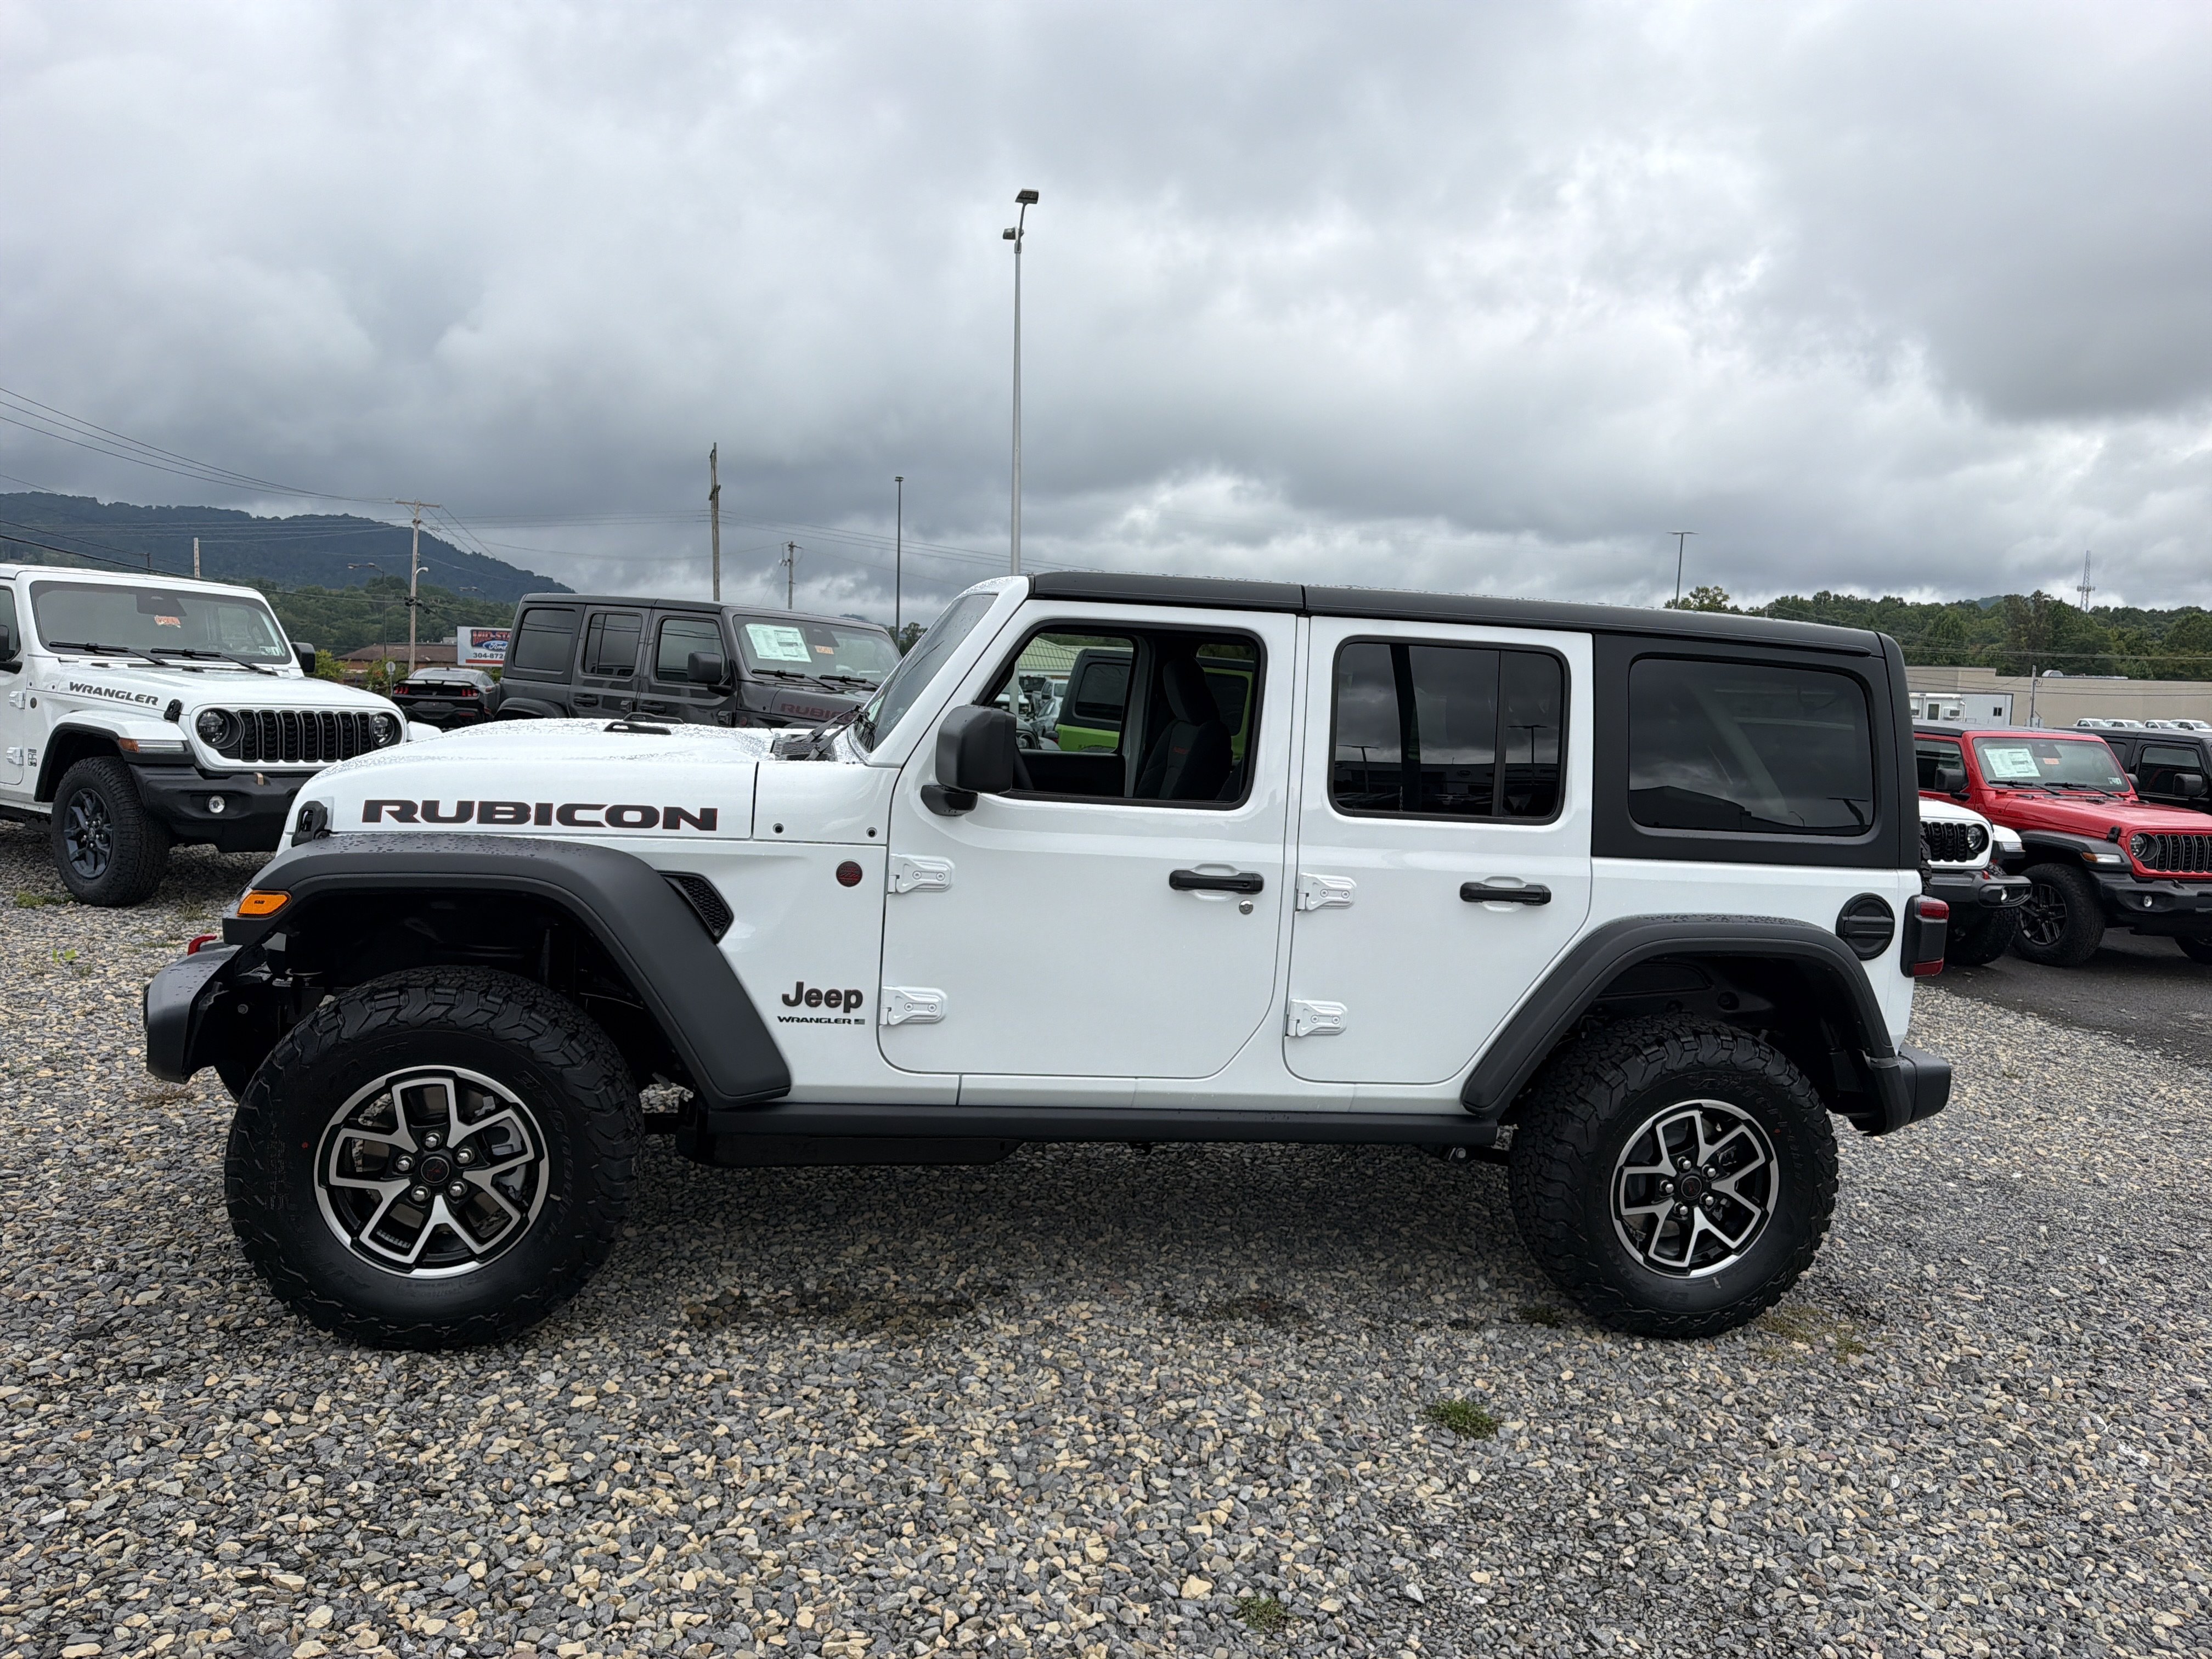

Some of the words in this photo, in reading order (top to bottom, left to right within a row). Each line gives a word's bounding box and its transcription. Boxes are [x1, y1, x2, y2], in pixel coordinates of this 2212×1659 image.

[472, 631, 511, 646] MID-STA
[488, 641, 507, 650] Ford
[69, 681, 159, 706] WRANGLER
[780, 703, 856, 723] RUBICO
[362, 799, 718, 831] RUBICON
[782, 981, 863, 1013] Jeep
[777, 1015, 852, 1025] WRANGLER
